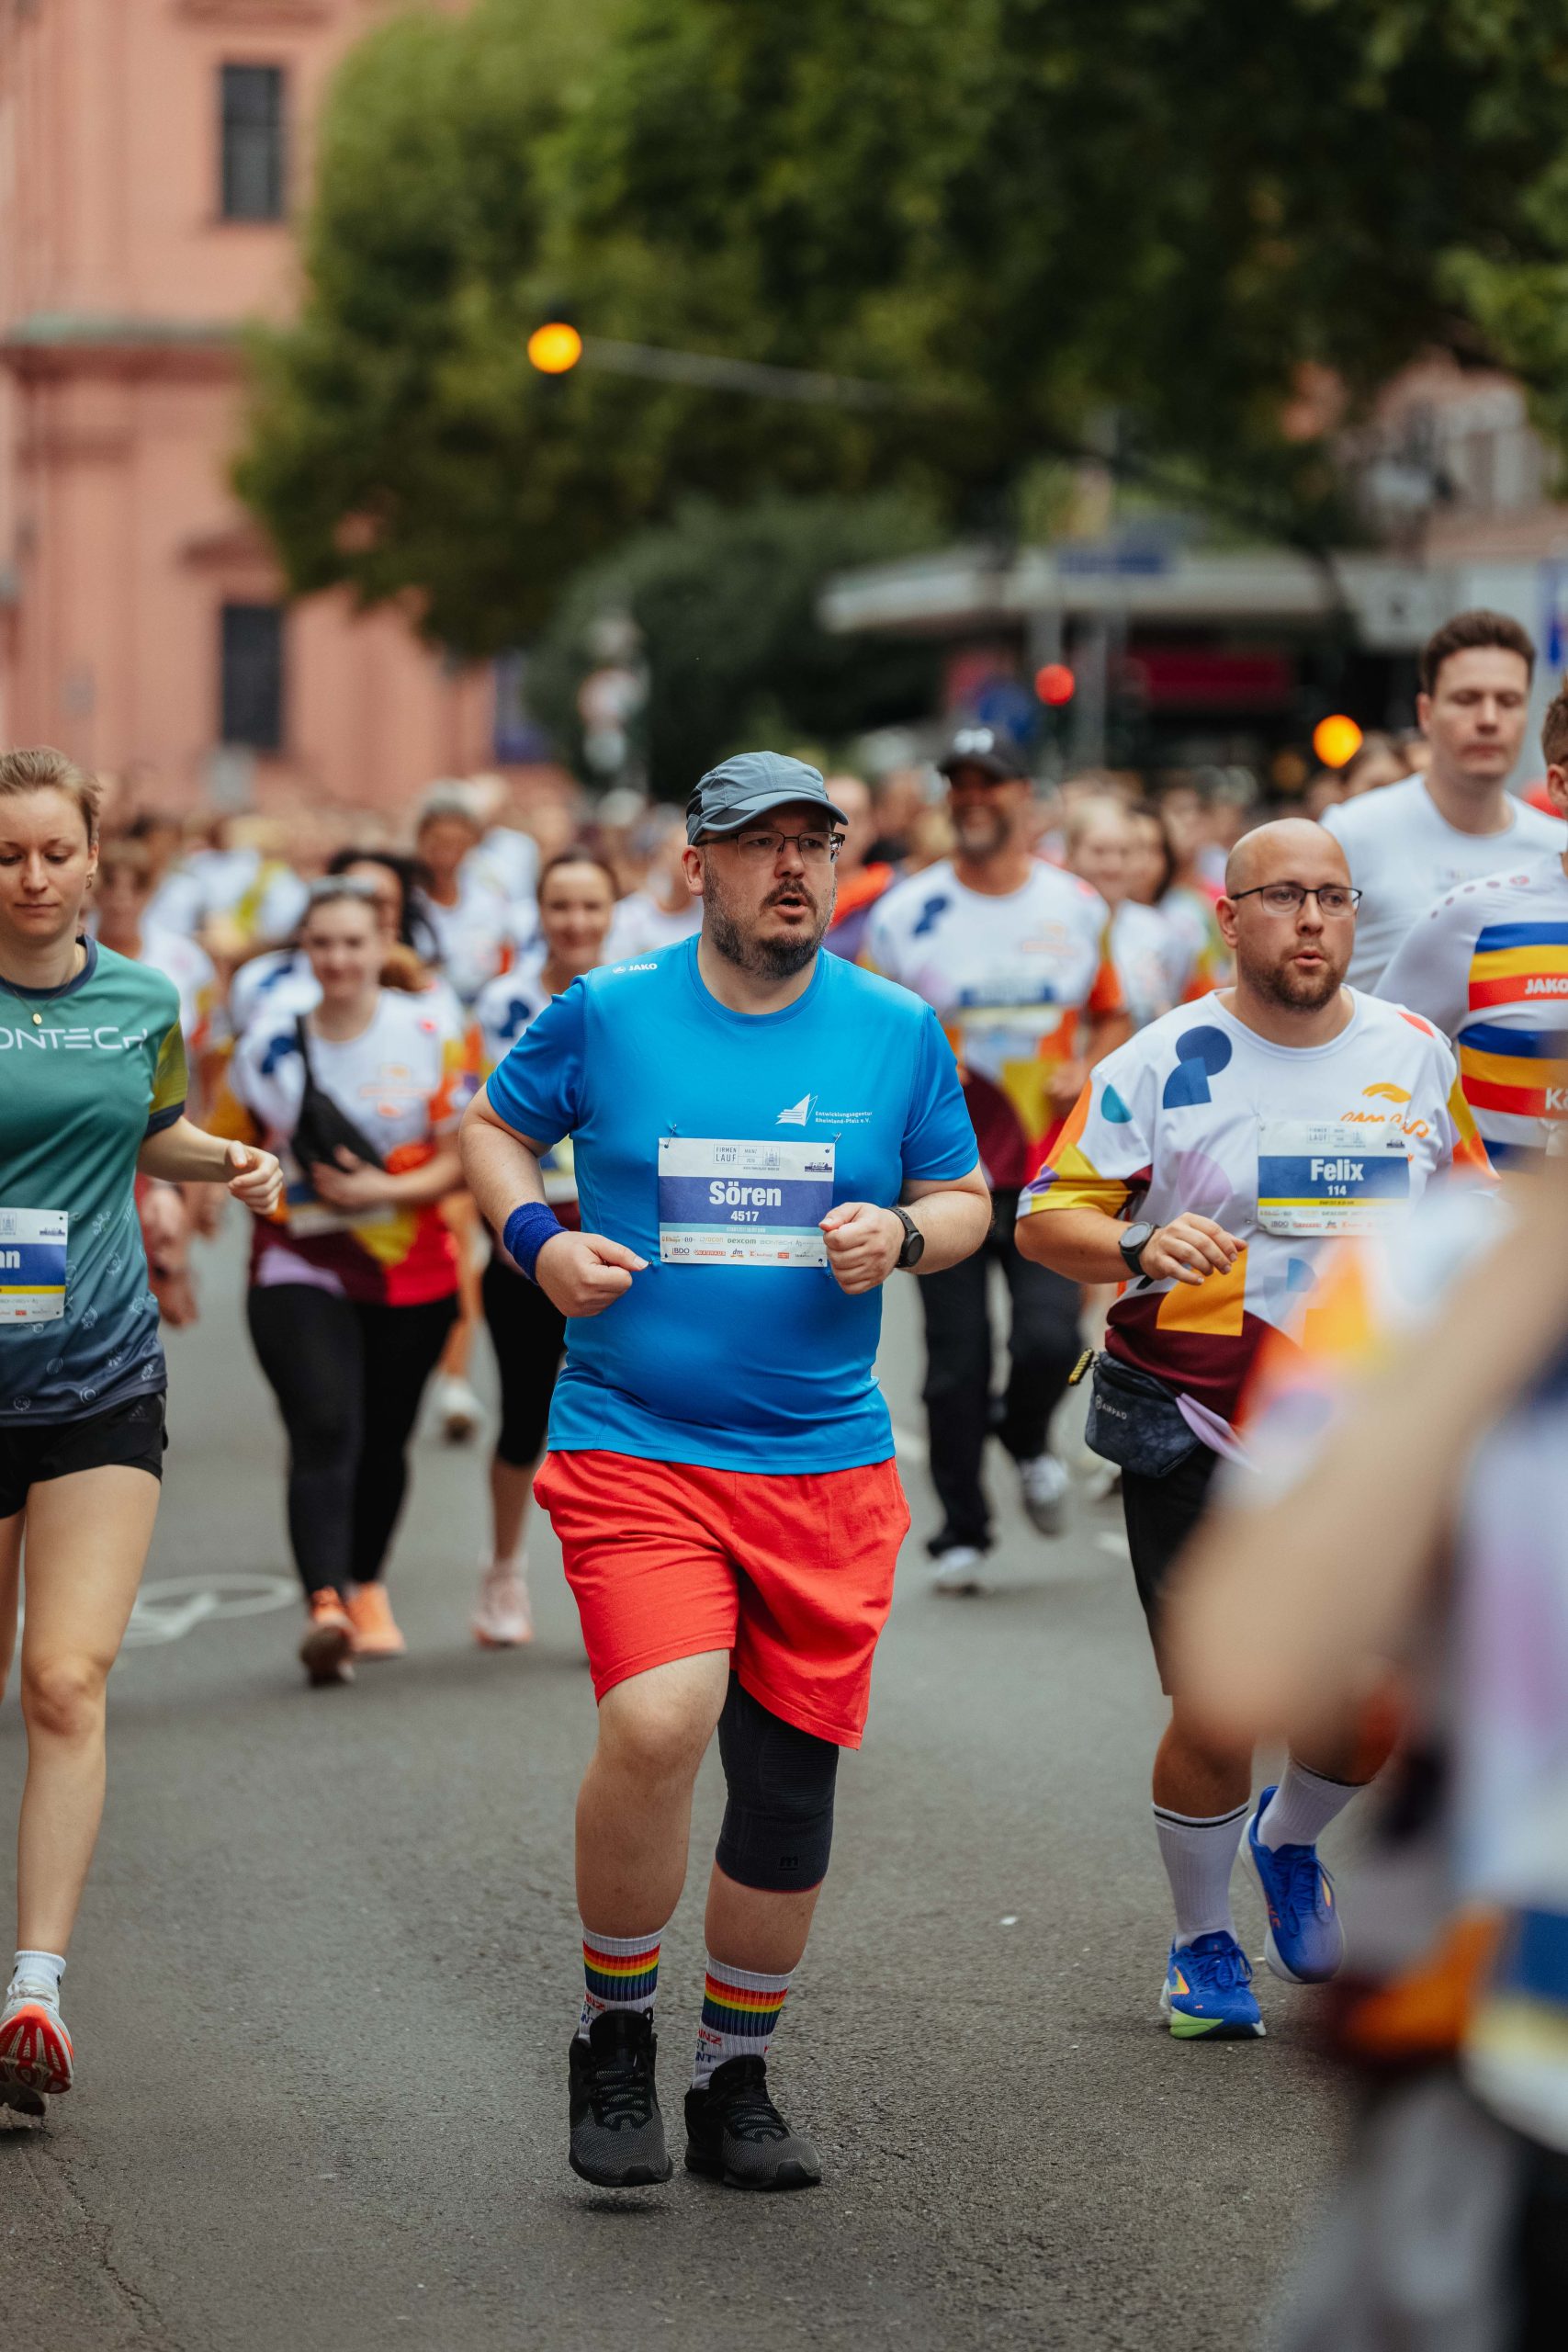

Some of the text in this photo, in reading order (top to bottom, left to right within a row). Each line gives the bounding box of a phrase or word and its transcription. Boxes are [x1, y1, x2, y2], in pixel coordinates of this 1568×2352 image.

[628, 963, 658, 971] JAKO
[716, 1154, 737, 1162] LAUF
[1310, 1159, 1364, 1182] Felix
[709, 1181, 782, 1206] Sören
[1327, 1185, 1347, 1196] 114
[730, 1210, 760, 1222] 4517
